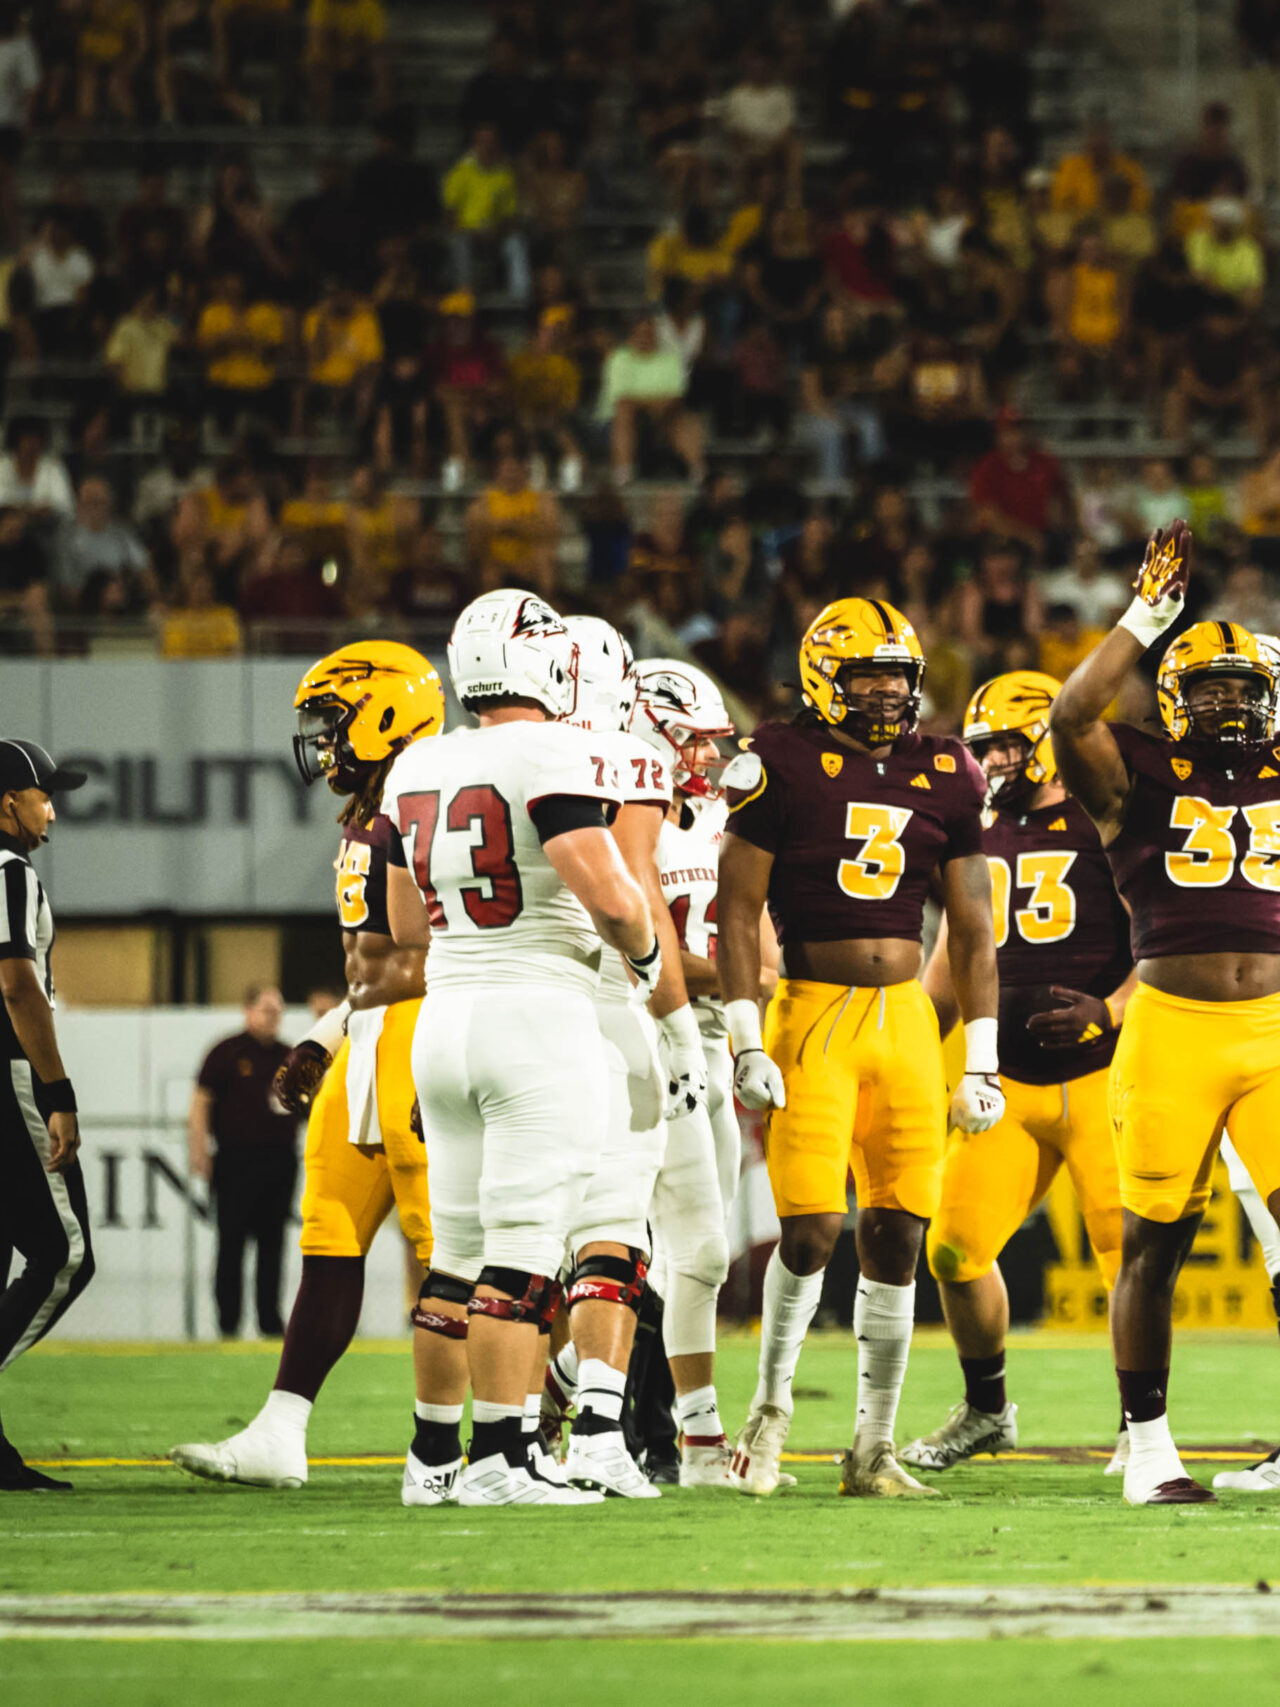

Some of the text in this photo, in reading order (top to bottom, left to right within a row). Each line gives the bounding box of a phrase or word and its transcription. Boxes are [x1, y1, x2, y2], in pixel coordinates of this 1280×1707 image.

[467, 681, 503, 694] schutt
[630, 758, 665, 791] 72
[397, 783, 524, 930] 73
[837, 801, 914, 900] 3
[660, 867, 718, 887] OUTHERN
